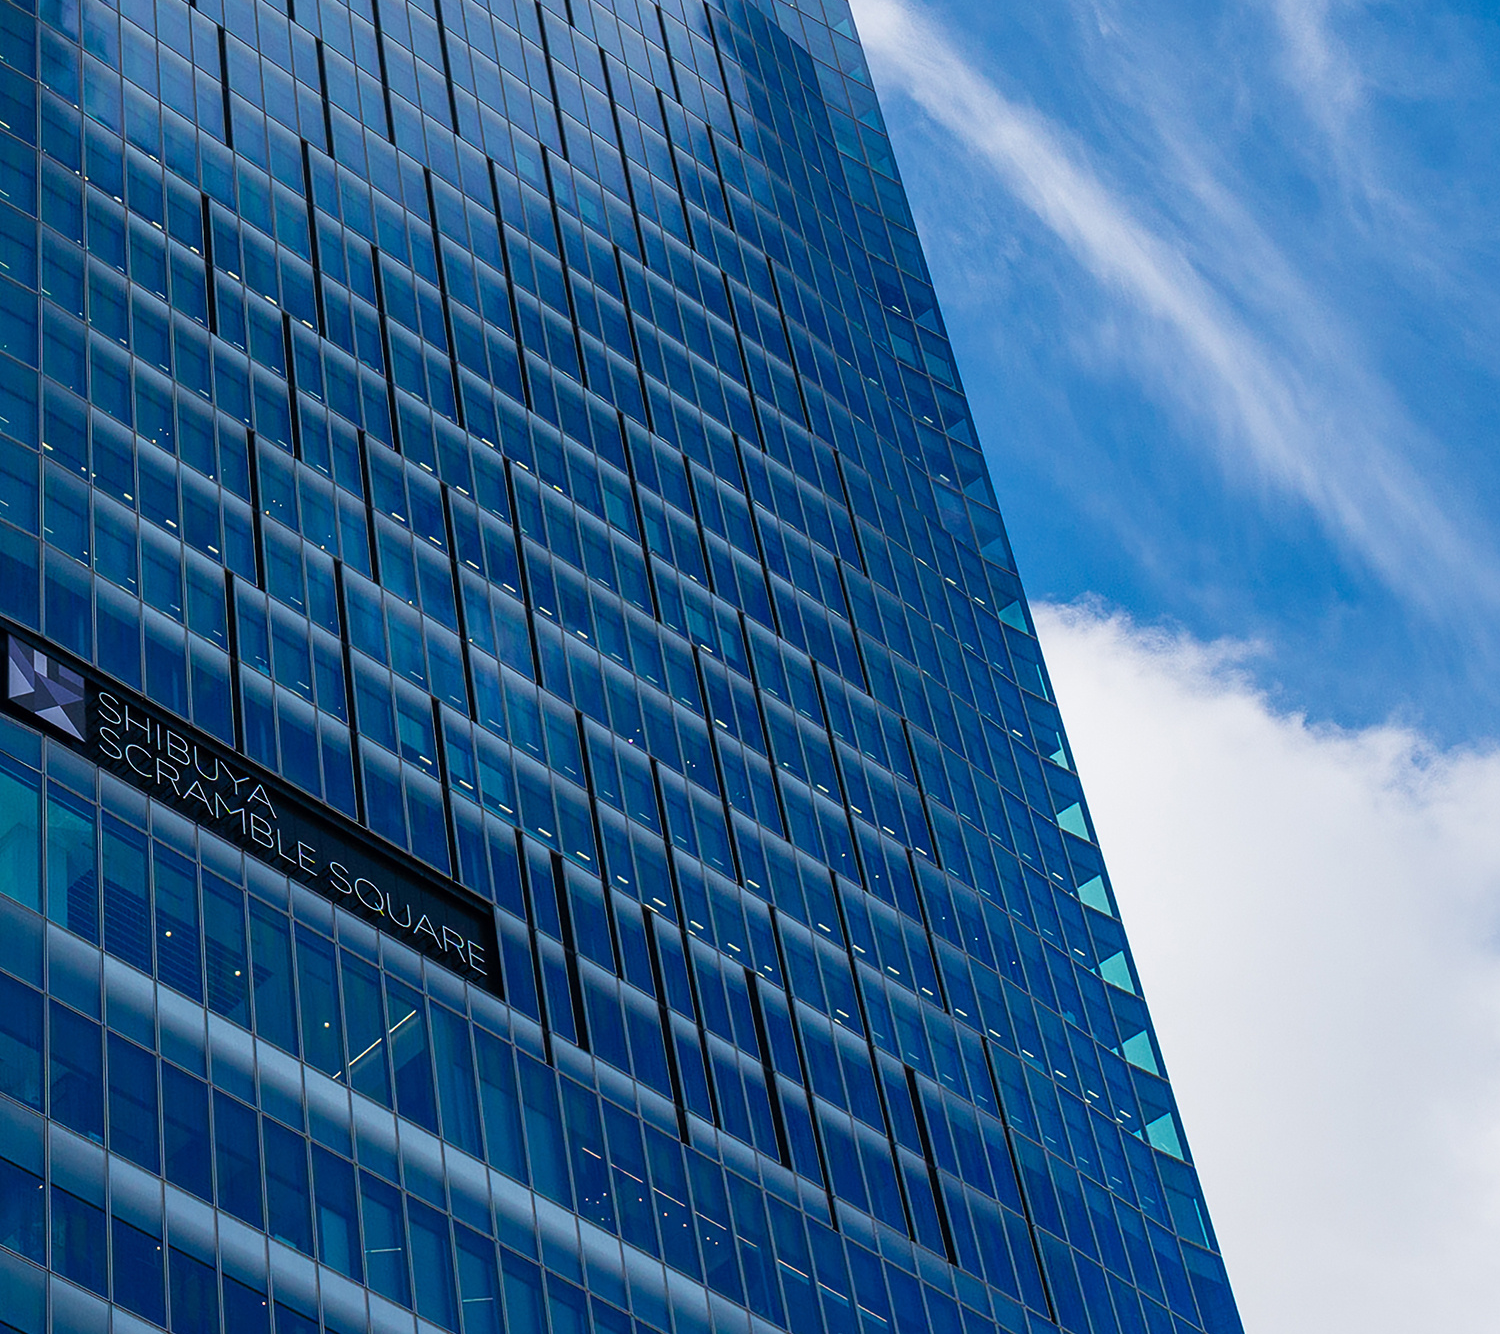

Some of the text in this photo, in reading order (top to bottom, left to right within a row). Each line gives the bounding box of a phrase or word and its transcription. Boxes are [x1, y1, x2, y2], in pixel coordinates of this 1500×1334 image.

[97, 691, 277, 819] SHIBUYA
[97, 725, 488, 976] SCRAMBLE SQUARE
